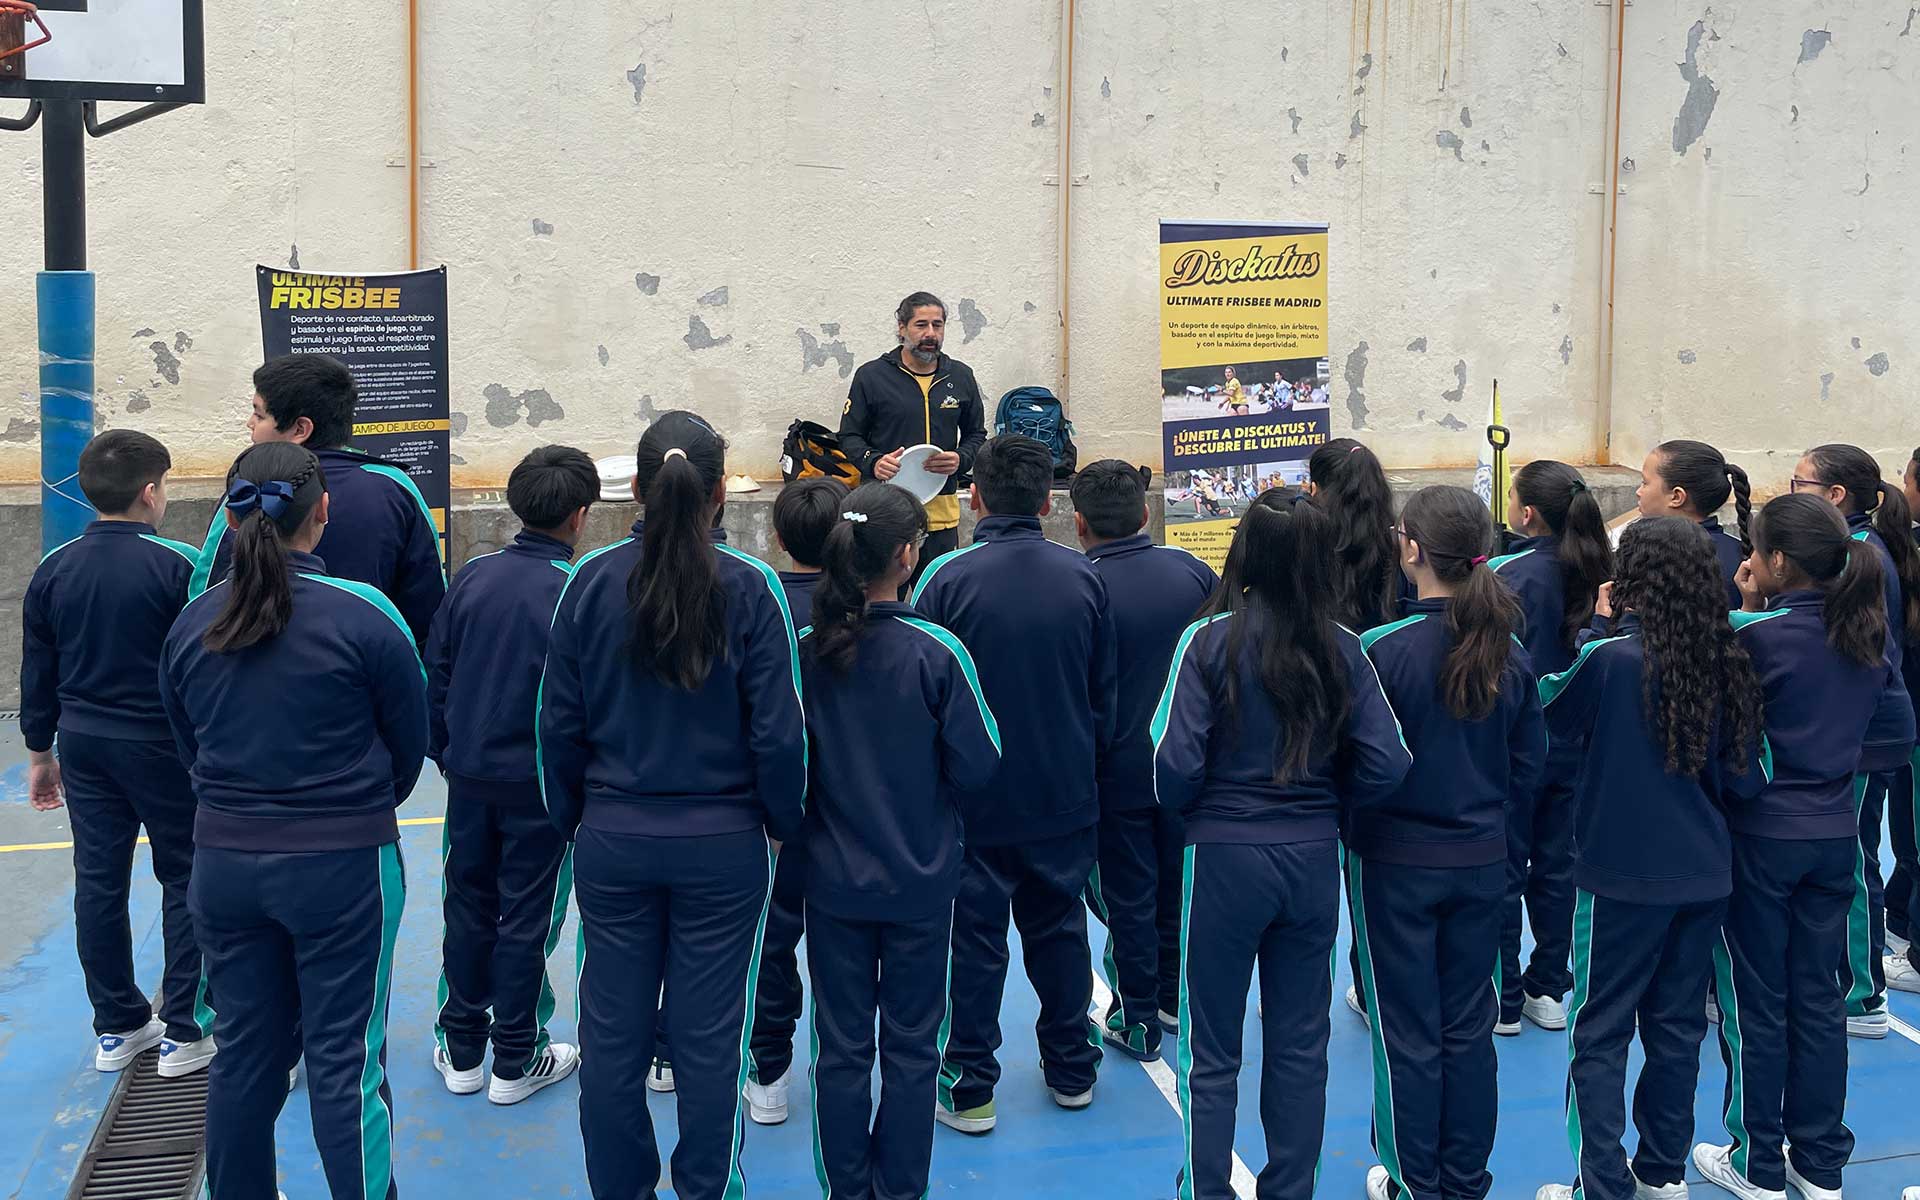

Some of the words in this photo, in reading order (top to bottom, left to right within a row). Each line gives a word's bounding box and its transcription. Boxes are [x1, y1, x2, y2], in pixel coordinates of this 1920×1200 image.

[1165, 244, 1320, 288] Disckatus
[270, 288, 401, 309] FRISBEE
[1166, 296, 1224, 306] ULTIMATE
[1226, 297, 1272, 306] FRISBEE
[1274, 298, 1322, 308] MADRID
[290, 315, 323, 324] Deporte
[324, 315, 334, 323] de
[346, 316, 382, 324] contacto,
[384, 314, 435, 322] autoarbitrado
[290, 327, 296, 336] y
[386, 324, 408, 334] juego,
[1256, 332, 1274, 340] juego
[332, 336, 352, 344] juego
[386, 334, 414, 343] respeto
[387, 423, 400, 432] DE
[402, 421, 435, 431] JUEGO
[1222, 428, 1232, 440] A
[1234, 424, 1306, 439] DISCKATUS
[1307, 422, 1316, 432] Y
[1174, 439, 1241, 456] DESCUBRE
[1244, 439, 1258, 451] EL
[1260, 433, 1326, 448] ULTIMATE!
